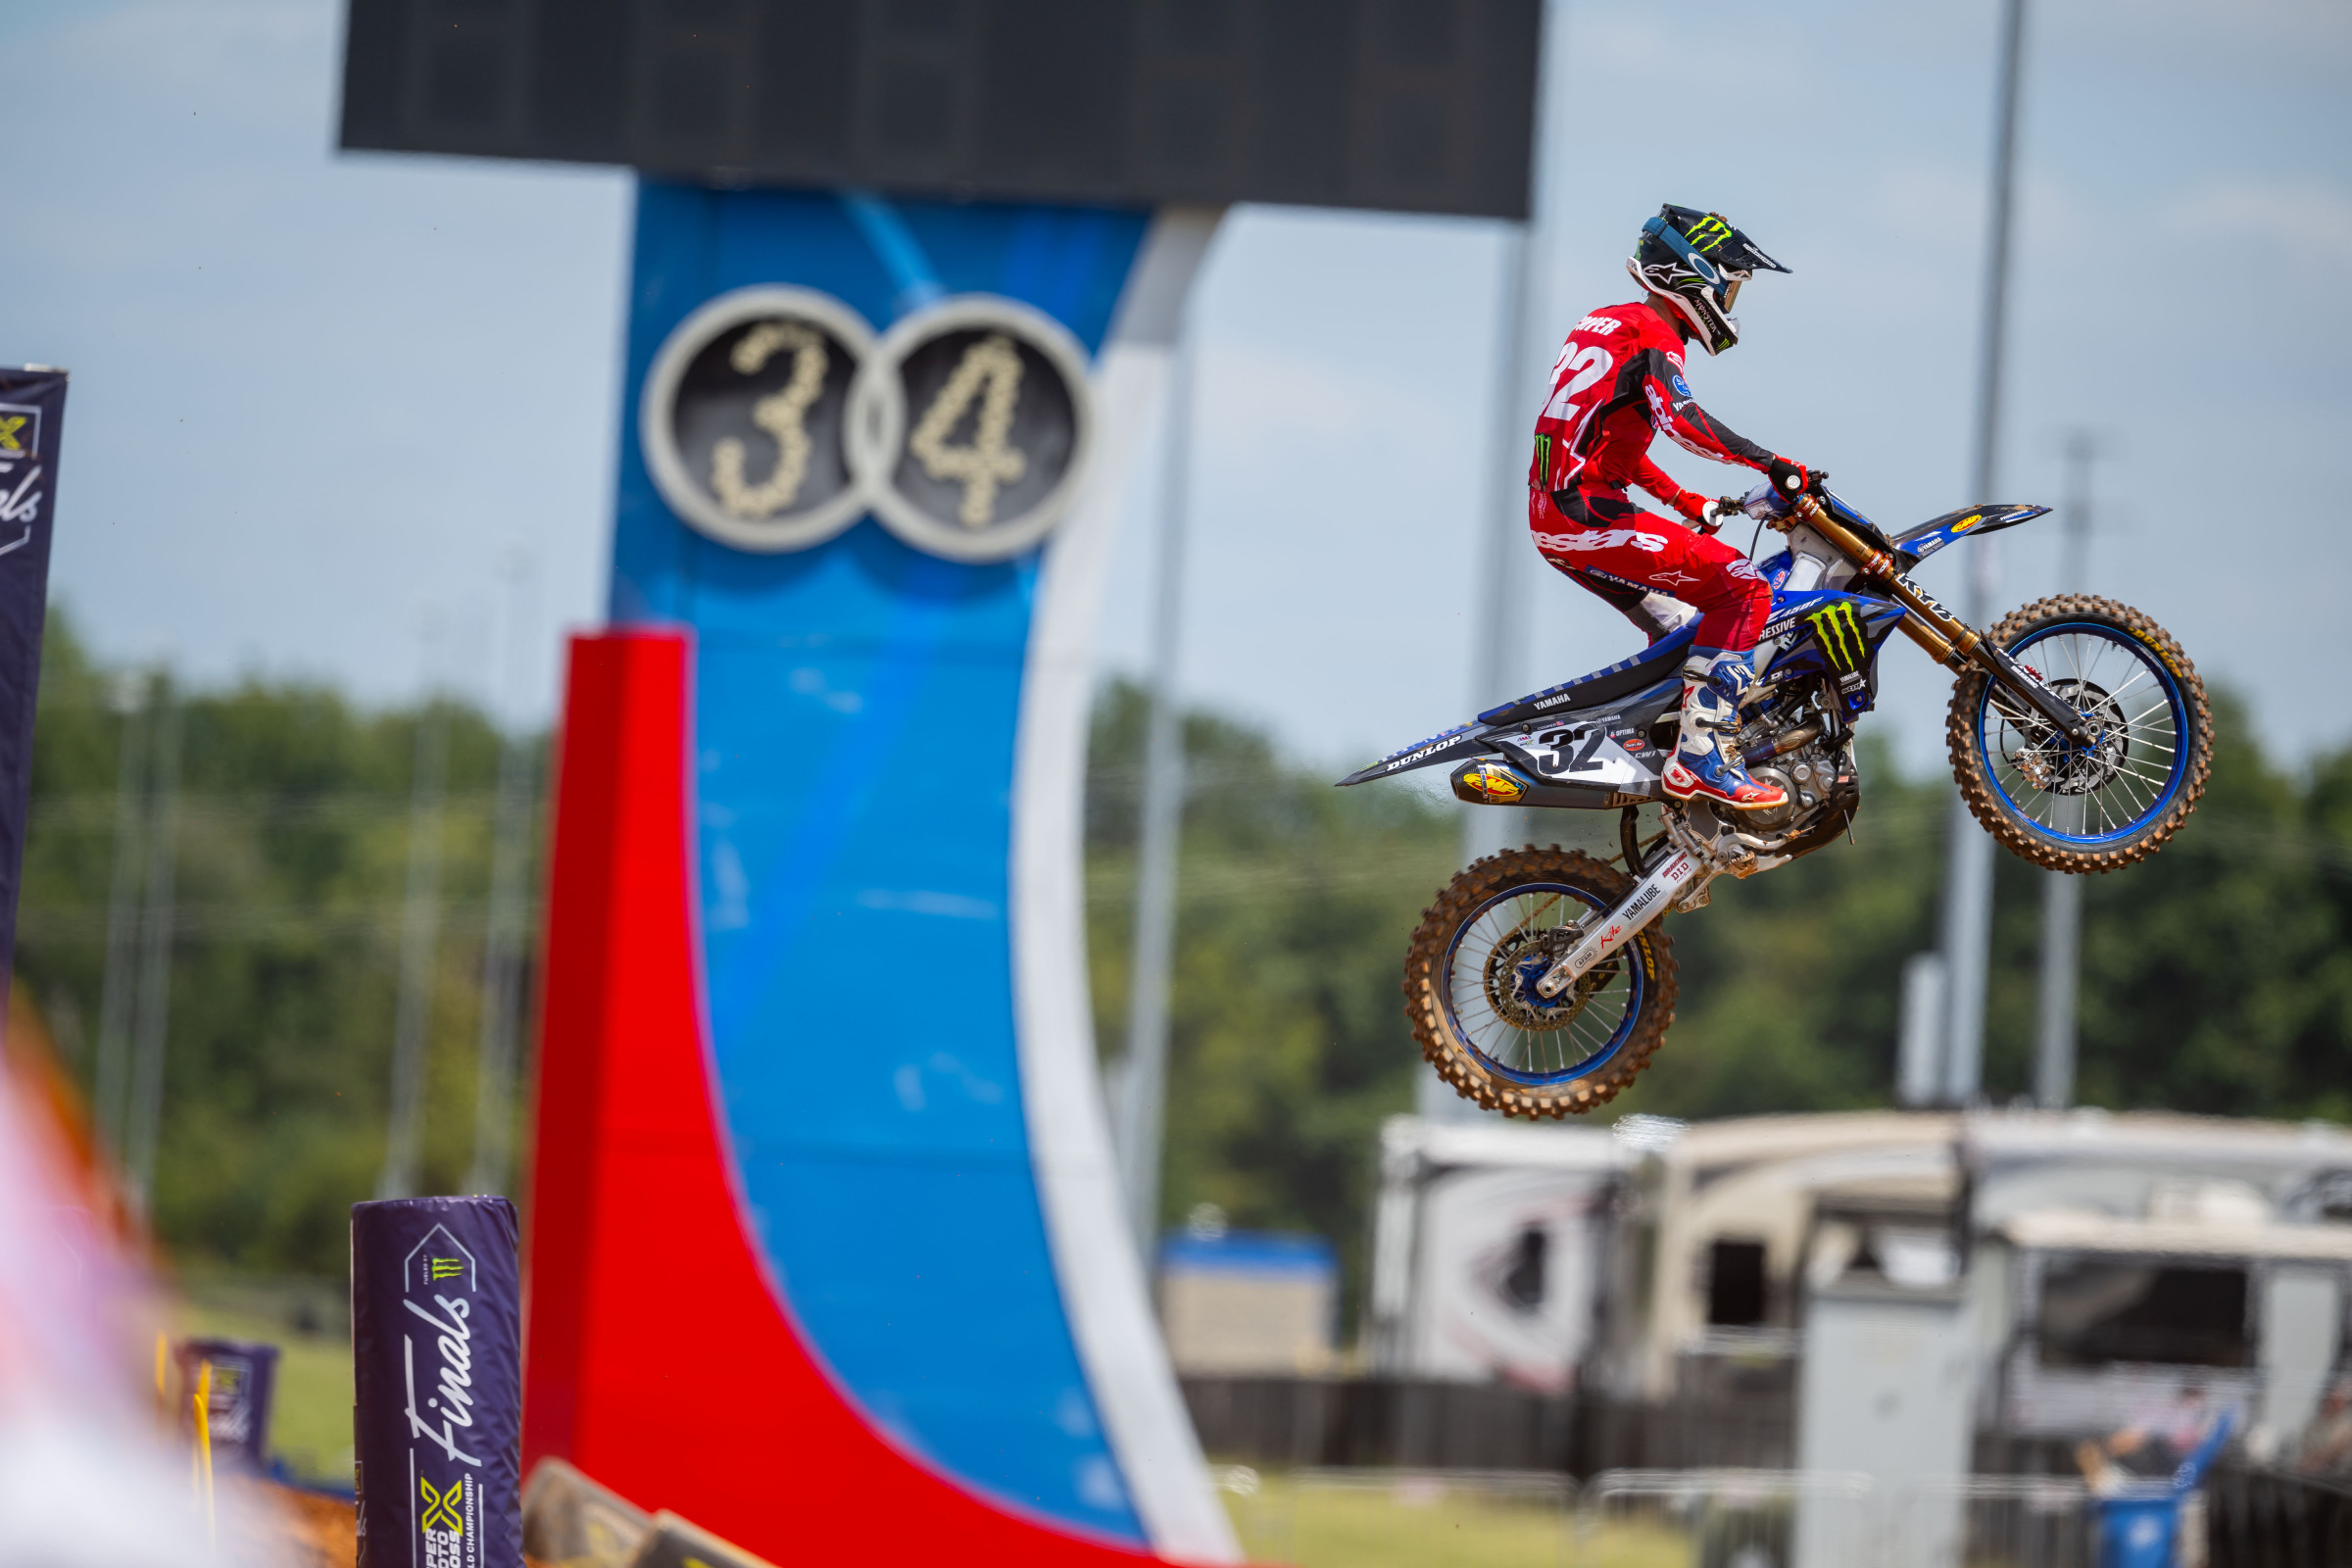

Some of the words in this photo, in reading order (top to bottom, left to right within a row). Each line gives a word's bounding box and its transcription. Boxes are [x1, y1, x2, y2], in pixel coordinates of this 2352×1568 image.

[1694, 299, 1717, 332] MONSTER
[710, 322, 829, 519] 3
[909, 333, 1026, 527] 4
[1923, 536, 1942, 550] YAMAHA
[2132, 627, 2182, 678] DUNLOP
[2011, 664, 2038, 689] BRAKING
[1533, 693, 1571, 710] YAMAHA
[1601, 713, 1622, 723] YAMAHA
[1615, 727, 1635, 737] OPTIMA
[1386, 734, 1462, 772] DUNLOP
[1538, 724, 1604, 776] 32
[1662, 851, 1689, 878] BRAKING
[1622, 883, 1661, 920] YAMALUBE
[1578, 951, 1592, 966] AFAM
[403, 1294, 482, 1467] Finals
[464, 1473, 475, 1552] CHAMPIONSHIP
